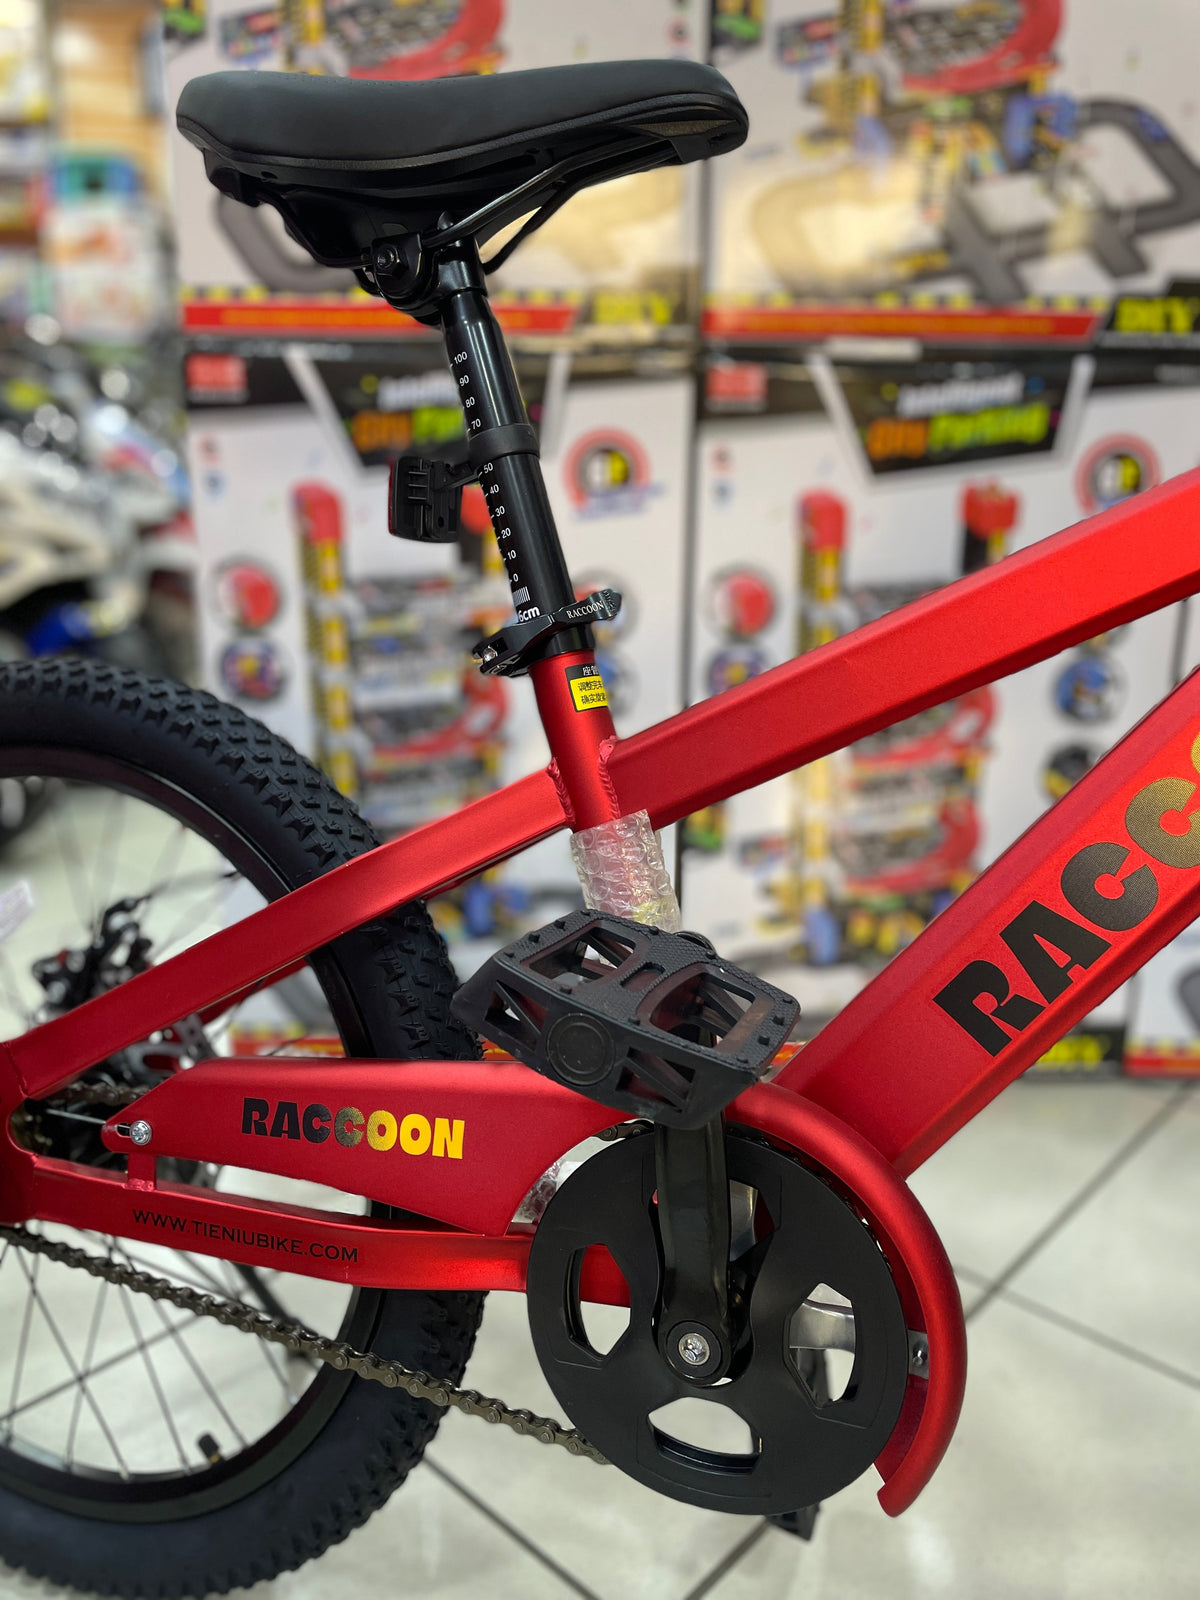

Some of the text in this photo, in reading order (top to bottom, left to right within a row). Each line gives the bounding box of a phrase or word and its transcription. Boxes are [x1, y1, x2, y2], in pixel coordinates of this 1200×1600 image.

[454, 352, 467, 364] 100
[460, 375, 469, 387] 90
[465, 396, 475, 408] 80
[471, 419, 481, 430] 70
[483, 463, 493, 473] 50
[490, 484, 499, 494] 40
[495, 506, 505, 516] 30
[501, 528, 511, 539] 20
[507, 550, 516, 560] 10
[512, 573, 519, 582] 0
[566, 600, 605, 619] RACCOON
[932, 730, 1200, 1057] RACC
[241, 1096, 466, 1160] RACCOON
[132, 1208, 359, 1264] WWW.TIENIUBIKE.COM
